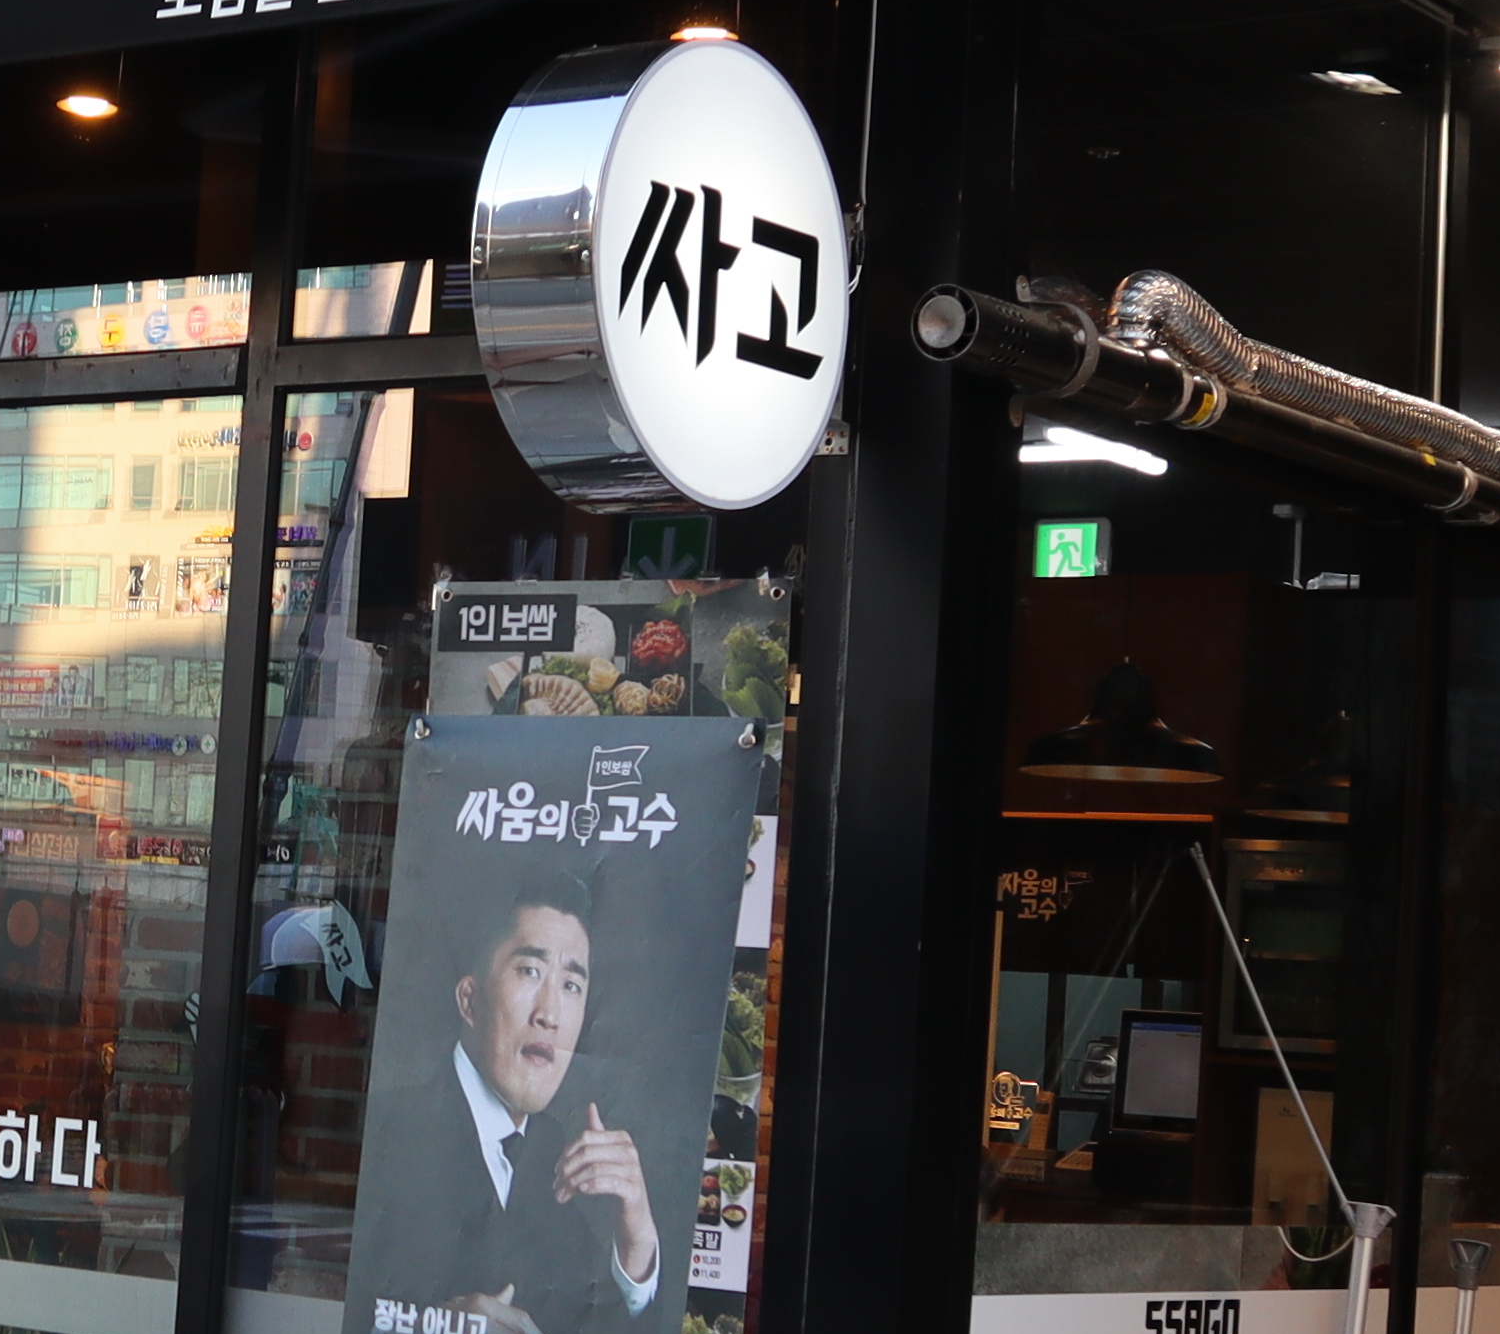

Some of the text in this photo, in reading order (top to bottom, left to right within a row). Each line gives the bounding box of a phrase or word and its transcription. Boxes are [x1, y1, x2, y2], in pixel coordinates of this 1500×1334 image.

[619, 179, 826, 381] 싸고
[458, 603, 558, 643] 1인 보쌈
[595, 760, 633, 777] 1인보쌈
[455, 781, 679, 850] 싸움의 고수
[1016, 897, 1058, 923] 고수
